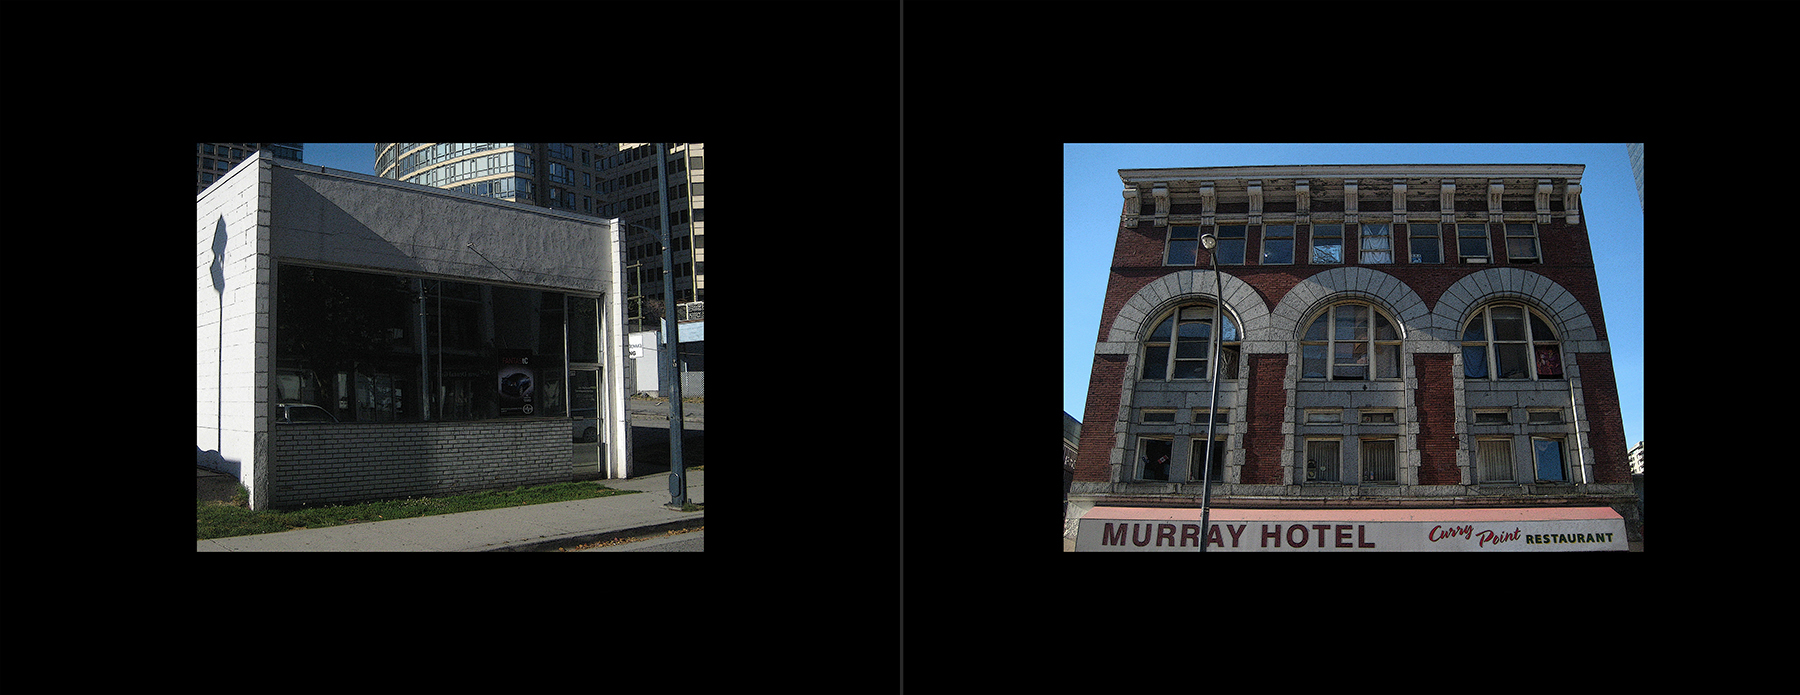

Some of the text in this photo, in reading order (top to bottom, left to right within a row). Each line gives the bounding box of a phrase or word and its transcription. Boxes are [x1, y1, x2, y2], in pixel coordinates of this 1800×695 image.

[1102, 523, 1375, 548] MURRAY HOTEL
[1429, 525, 1613, 548] Curry Point RESTAURANT
